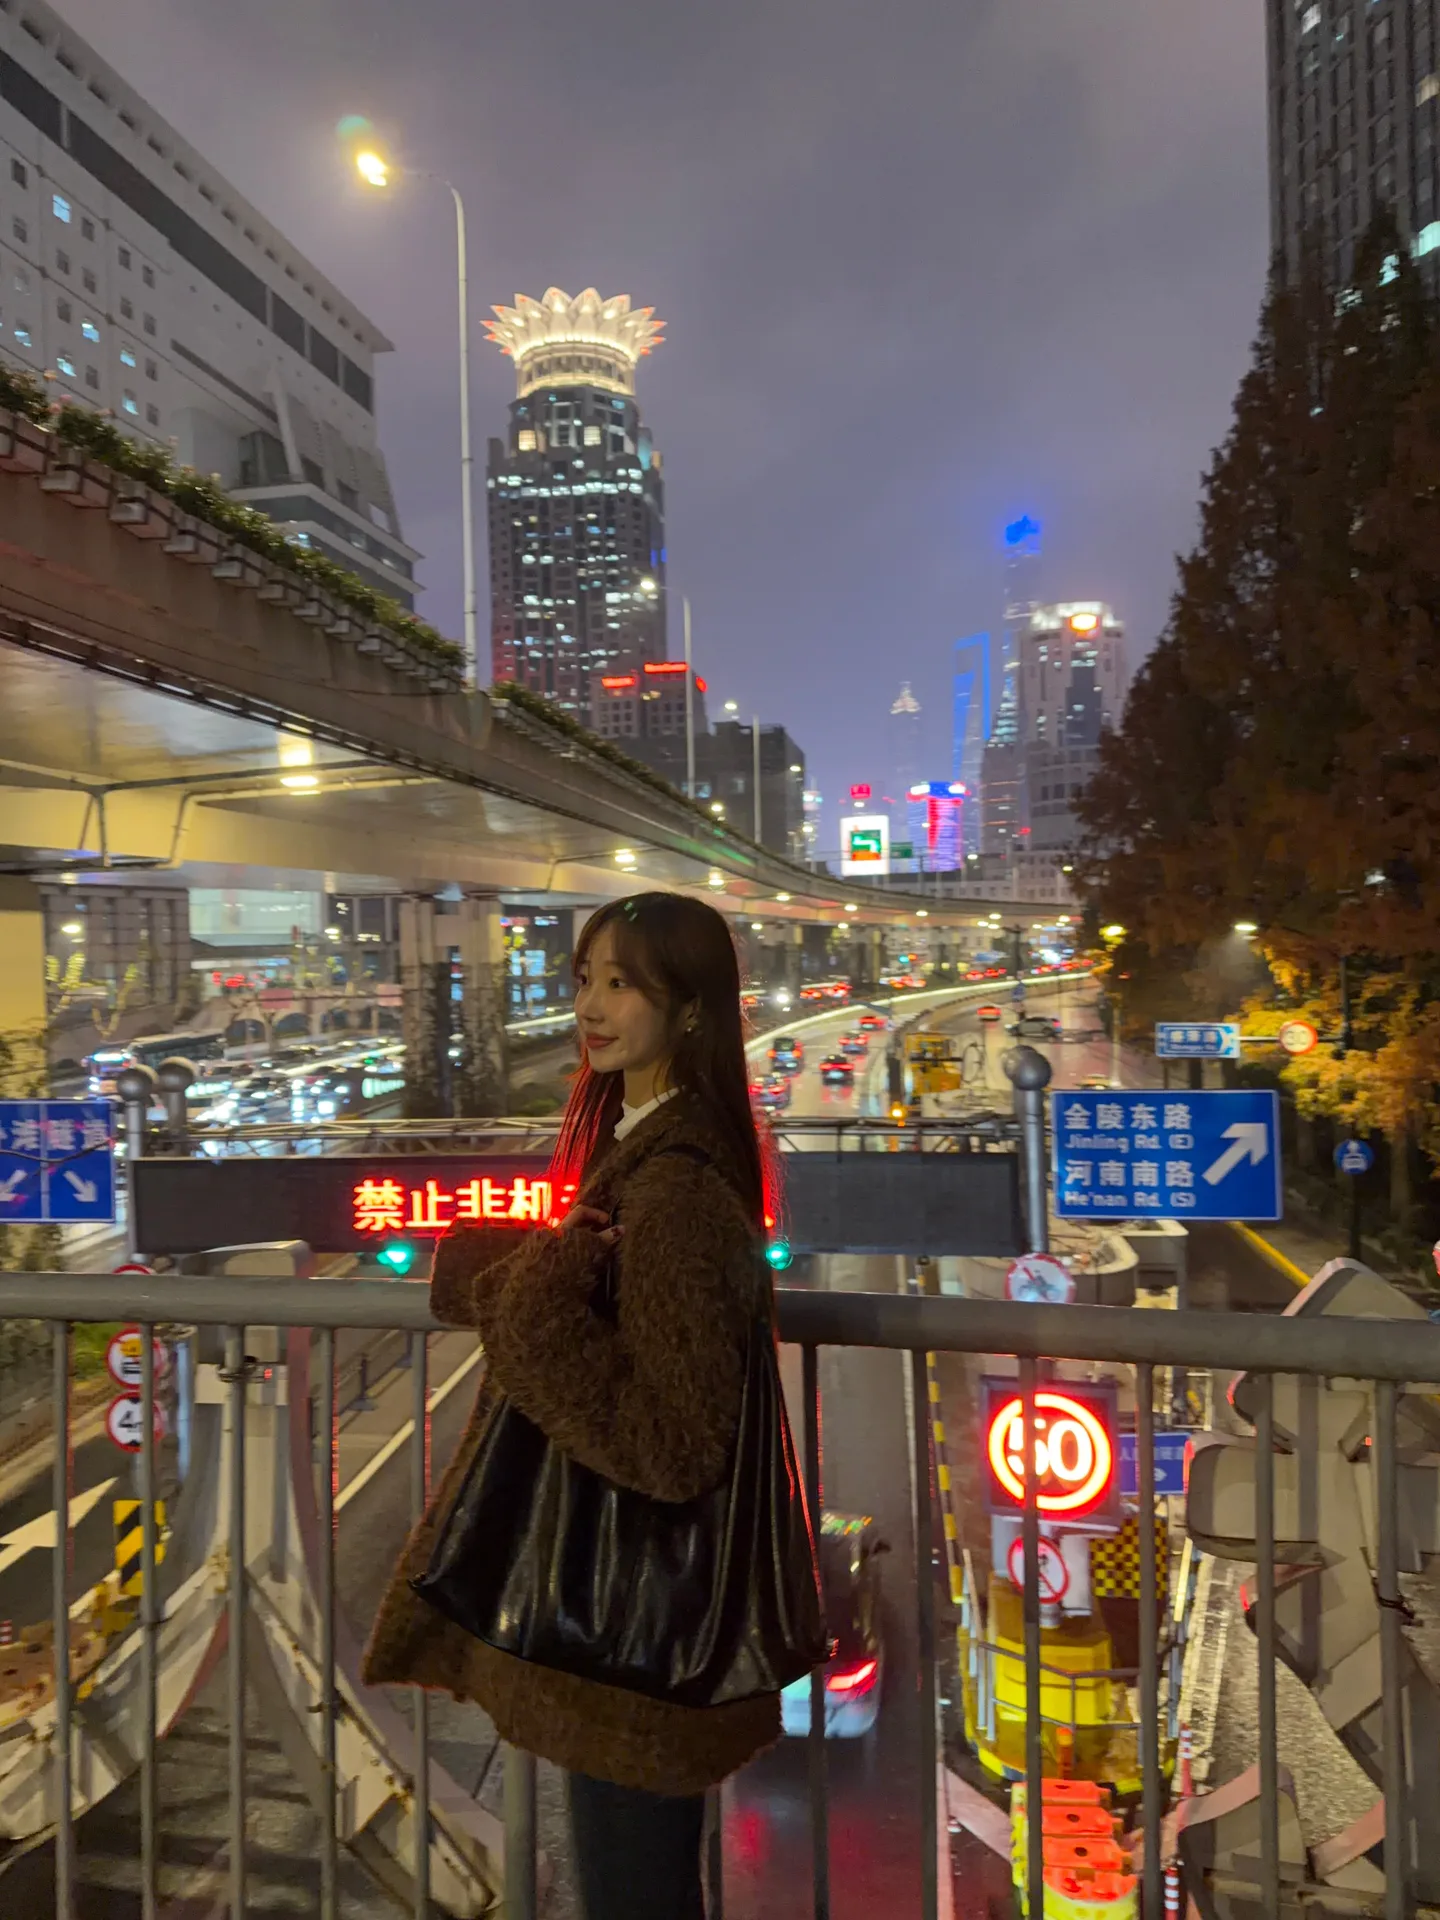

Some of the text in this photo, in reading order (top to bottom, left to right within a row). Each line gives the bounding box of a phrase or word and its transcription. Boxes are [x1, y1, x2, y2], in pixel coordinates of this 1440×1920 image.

[1064, 1103, 1192, 1130] 金陵东路
[1065, 1134, 1129, 1153] Jinling
[1064, 1159, 1195, 1187] 河南南路
[352, 1177, 577, 1229] 禁止非机
